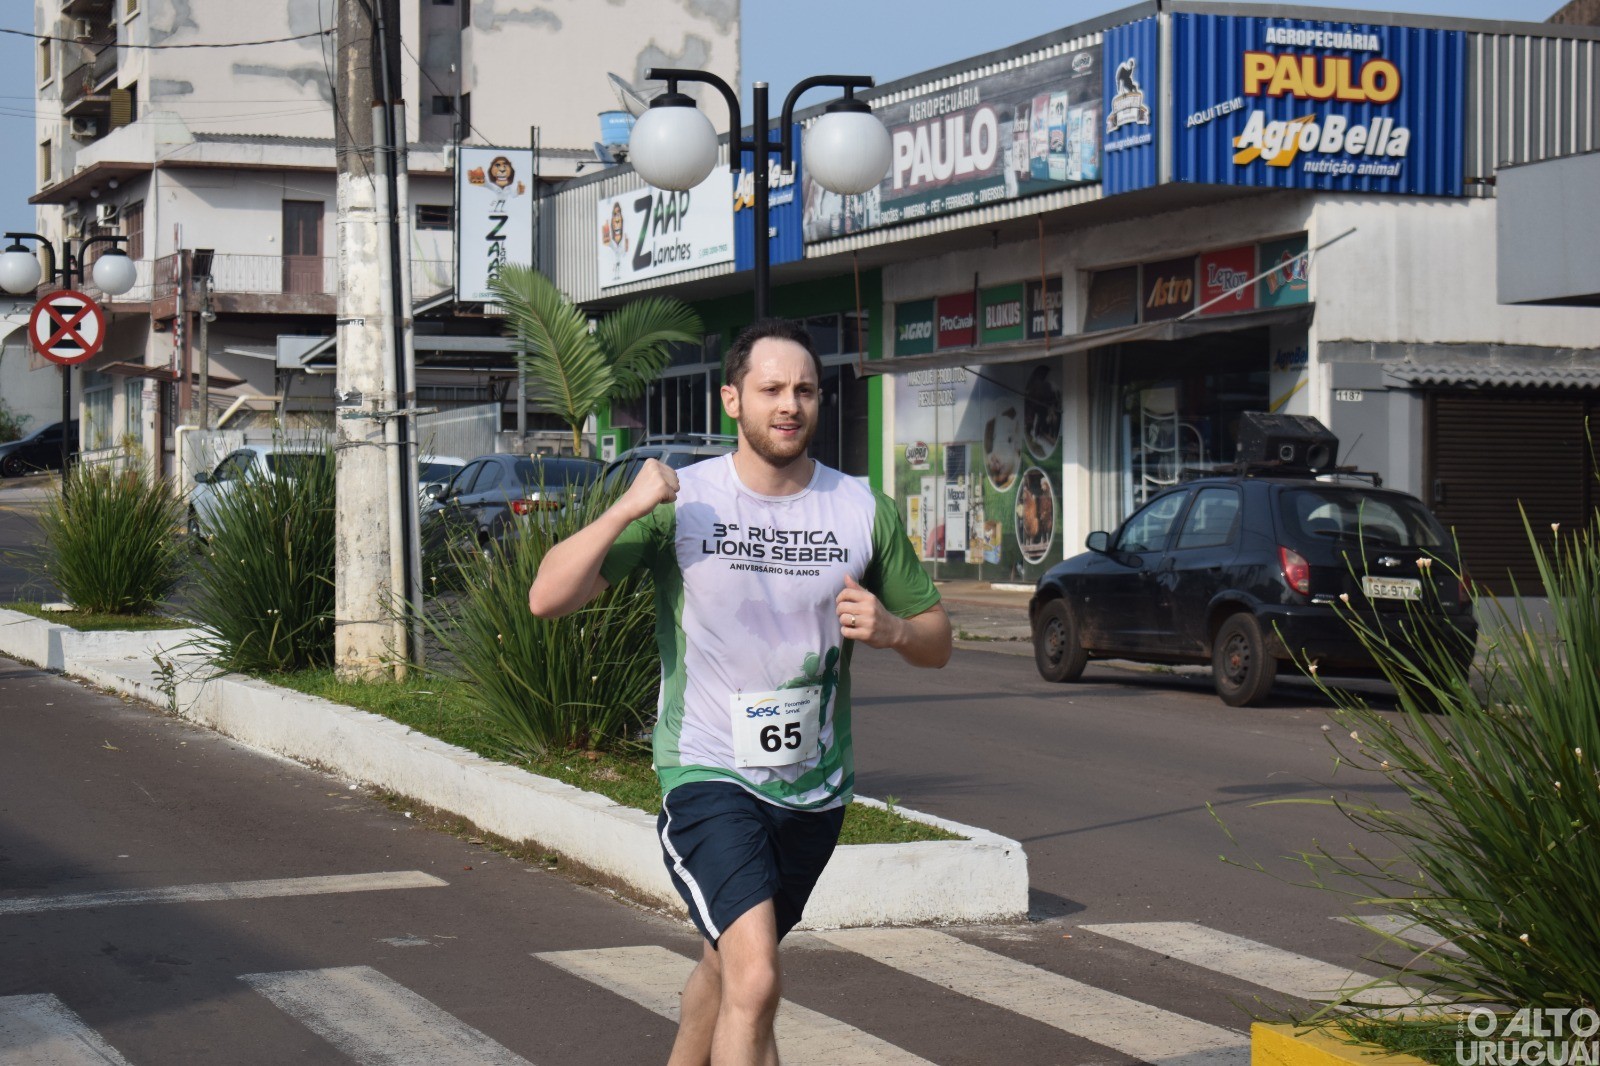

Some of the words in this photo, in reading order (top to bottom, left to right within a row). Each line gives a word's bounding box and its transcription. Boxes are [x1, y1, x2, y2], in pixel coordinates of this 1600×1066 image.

[1265, 26, 1380, 51] AGROPECUÁRIA
[1244, 52, 1400, 102] PAULO
[908, 86, 979, 122] AGROPECUÁRIA
[1187, 106, 1216, 128] AQUI
[1215, 97, 1243, 117] TEM!
[892, 107, 998, 190] PAULO
[1237, 110, 1411, 160] AgroBella
[1304, 159, 1354, 176] nutrição
[1357, 161, 1400, 176] animal
[930, 199, 941, 214] PET
[979, 185, 1006, 202] DIVERSOS
[632, 189, 691, 272] ZAAP
[652, 237, 691, 268] Lanches
[1146, 275, 1193, 308] Astro
[985, 302, 1021, 329] BLOKUS
[1337, 391, 1361, 401] 1187
[702, 539, 766, 559] LIONS
[771, 545, 849, 563] SEBERI
[748, 526, 839, 546] RÚSTICA
[729, 563, 783, 575] ANIVERSÁRIO
[796, 569, 820, 577] ANOS
[760, 722, 802, 753] 65
